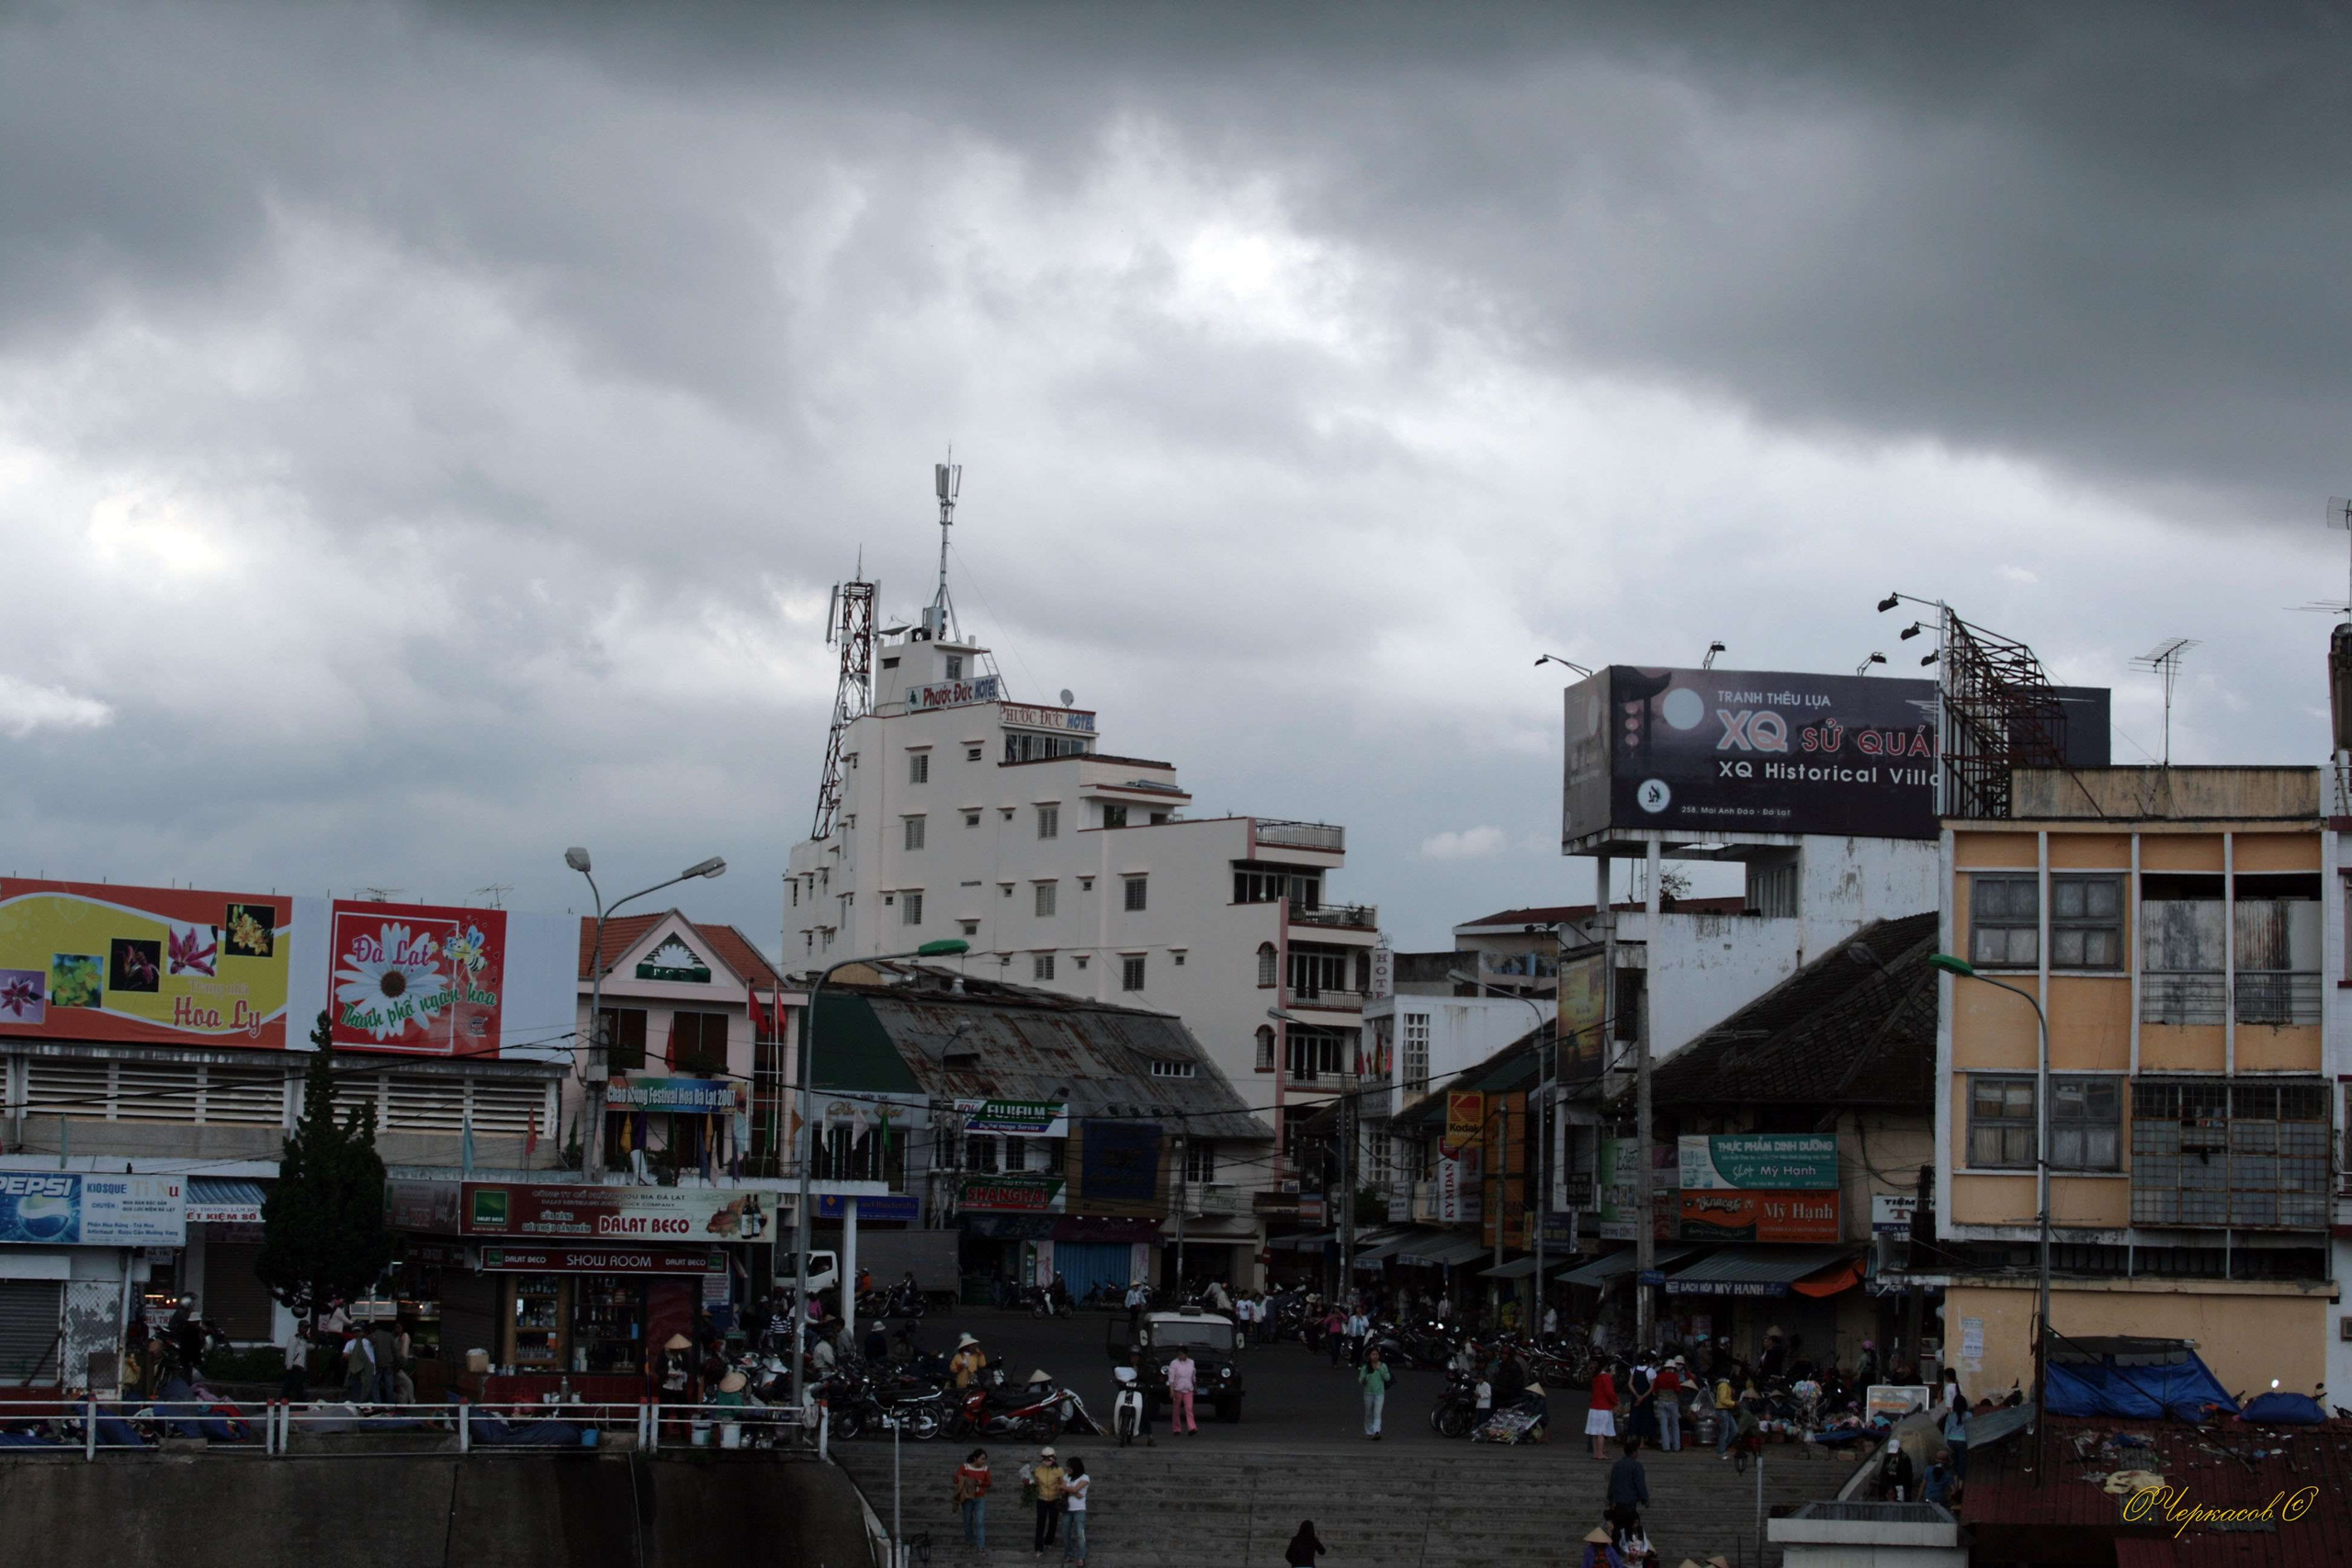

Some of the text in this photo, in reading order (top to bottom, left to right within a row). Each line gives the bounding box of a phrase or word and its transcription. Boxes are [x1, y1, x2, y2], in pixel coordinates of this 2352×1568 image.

[923, 678, 997, 706] Phước Đức HOTEL
[1718, 691, 1831, 710] TRANH THÊU LỤA
[1067, 714, 1094, 731] HOTEL
[1715, 709, 1939, 758] XQ SỬ QUÁ
[1718, 761, 1753, 778] XQ
[1765, 761, 1878, 784] Historical
[391, 939, 431, 973] Lạt
[467, 982, 497, 1007] hoa
[173, 996, 262, 1039] Hoa Ly
[649, 1086, 678, 1104] Festival
[718, 1089, 736, 1107] 2007
[1449, 1122, 1480, 1133] Kodak
[86, 1183, 128, 1195] KIOSQUE
[966, 1186, 1049, 1202] SHANGHAI
[1445, 1163, 1454, 1219] KYMDAN
[1763, 1201, 1834, 1223] Mỹ Hạnh
[600, 1215, 690, 1235] DALAT BECO
[527, 1256, 548, 1264] BECO
[566, 1255, 606, 1267] SHOW
[609, 1255, 652, 1268] ROOM
